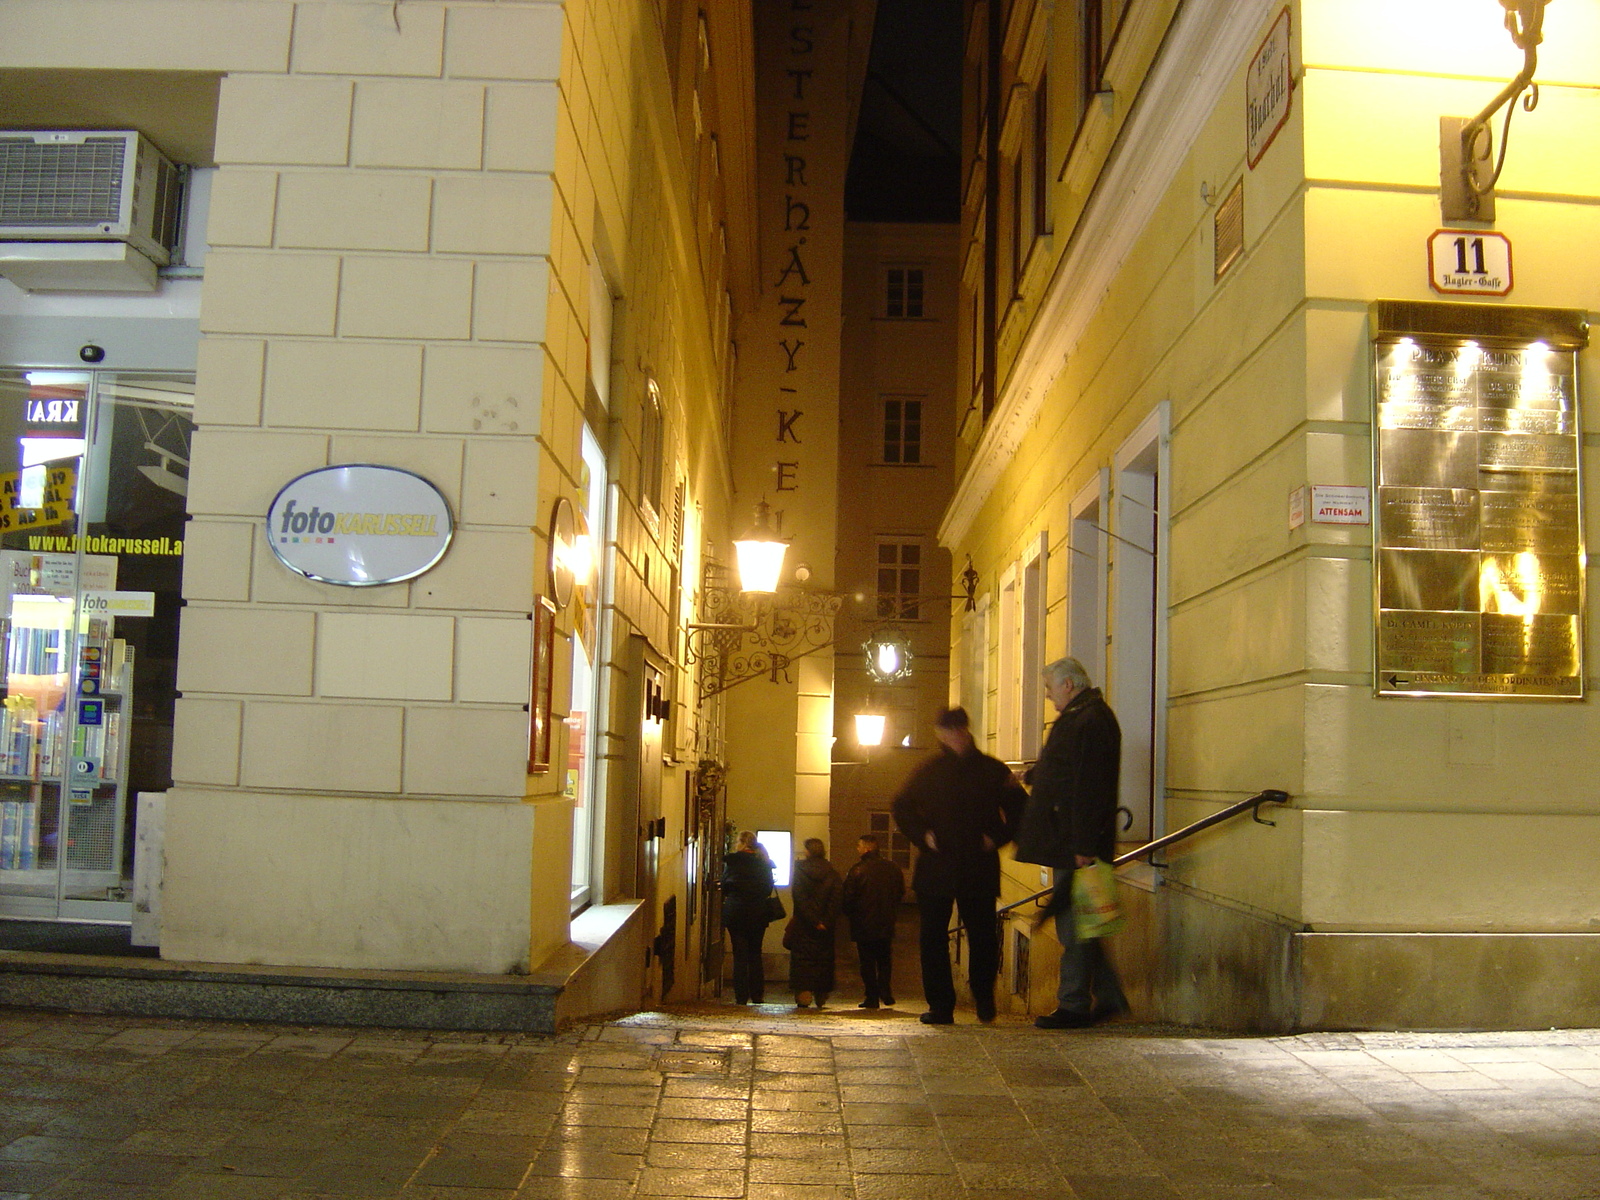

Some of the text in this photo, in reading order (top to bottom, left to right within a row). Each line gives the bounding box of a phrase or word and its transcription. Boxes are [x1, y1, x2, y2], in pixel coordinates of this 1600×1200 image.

[1453, 237, 1489, 275] 11
[1319, 508, 1363, 517] ATTENSAM
[29, 535, 184, 556] www.ftokarussell.a
